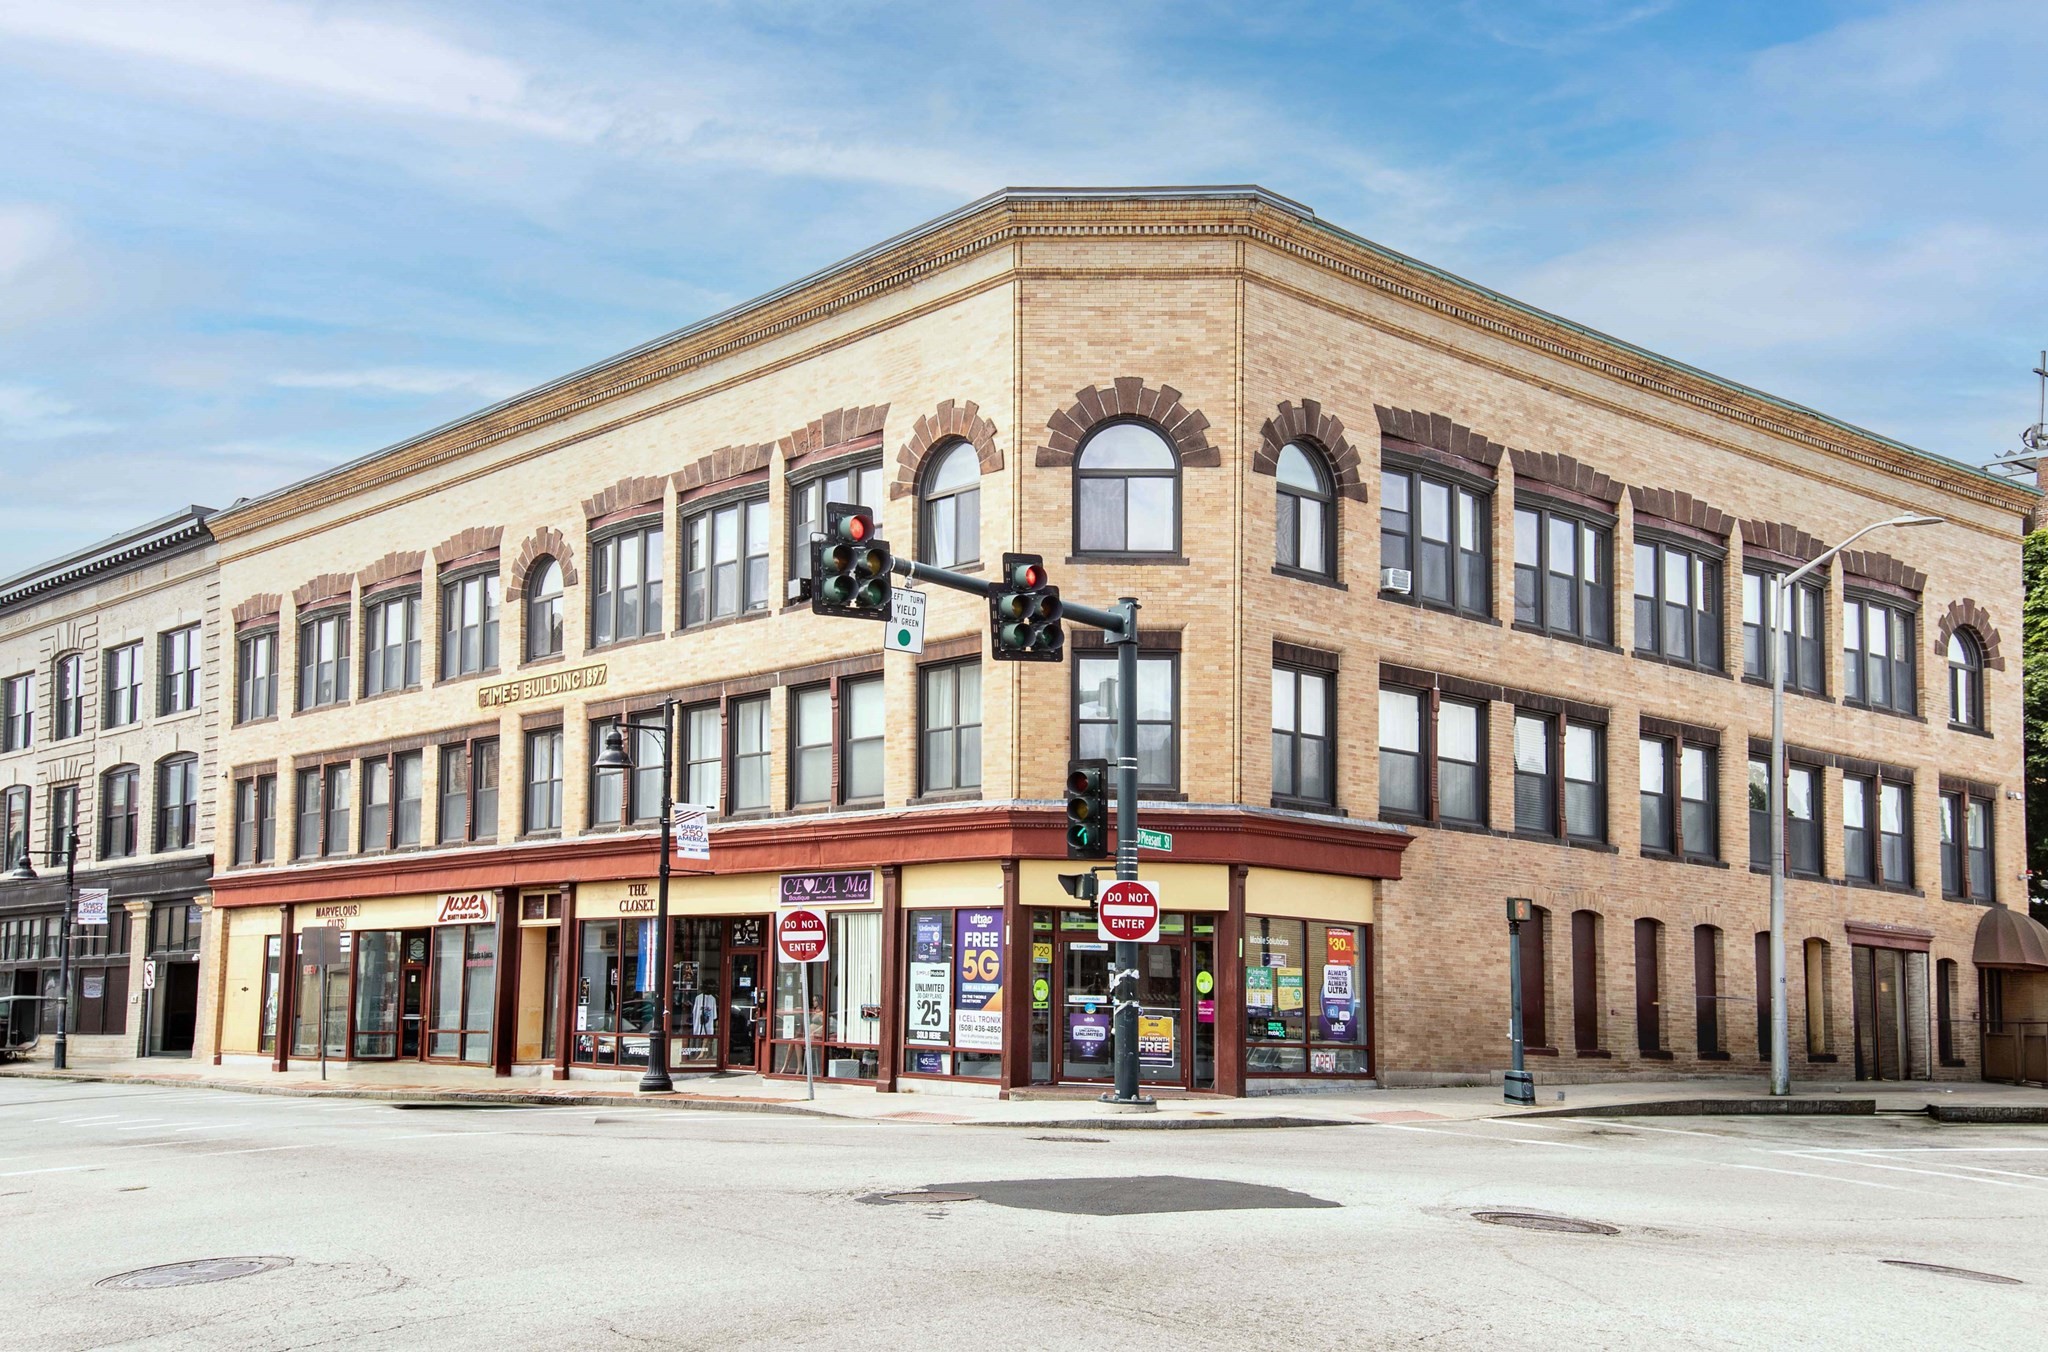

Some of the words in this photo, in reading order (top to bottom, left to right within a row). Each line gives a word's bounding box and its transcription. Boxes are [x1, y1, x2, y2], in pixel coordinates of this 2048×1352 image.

[891, 592, 903, 601] EFT
[910, 596, 923, 604] TURN
[897, 604, 917, 616] YIELD
[901, 617, 919, 627] GREEN
[479, 684, 519, 706] TIMES
[523, 672, 581, 699] BUILDING
[682, 829, 703, 838] 250
[1141, 831, 1161, 847] Pleasant
[1164, 835, 1170, 849] St
[628, 884, 648, 896] THE
[1107, 892, 1122, 903] DO
[1128, 893, 1149, 903] NOT
[315, 905, 358, 917] MARVELOUS
[619, 899, 656, 912] CLOSET
[327, 918, 345, 929] CUTS
[784, 920, 797, 929] DO
[801, 920, 819, 928] NOT
[1111, 918, 1145, 929] ENTER
[964, 931, 999, 948] FREE
[1328, 937, 1346, 951] $30
[789, 942, 817, 951] ENTER
[962, 949, 1000, 981] 5G
[1327, 969, 1348, 977] ALWAYS
[915, 983, 945, 992] UNLIMITED
[1327, 986, 1348, 995] ULTRA
[916, 999, 942, 1027] $25
[978, 1015, 1002, 1024] TRONIX
[958, 1024, 974, 1033] (508)
[974, 1025, 1002, 1034] 436-4850
[916, 1031, 928, 1039] SOLD
[928, 1031, 942, 1040] HERE
[1138, 1041, 1170, 1053] FREE
[1315, 1054, 1336, 1071] OPEN
